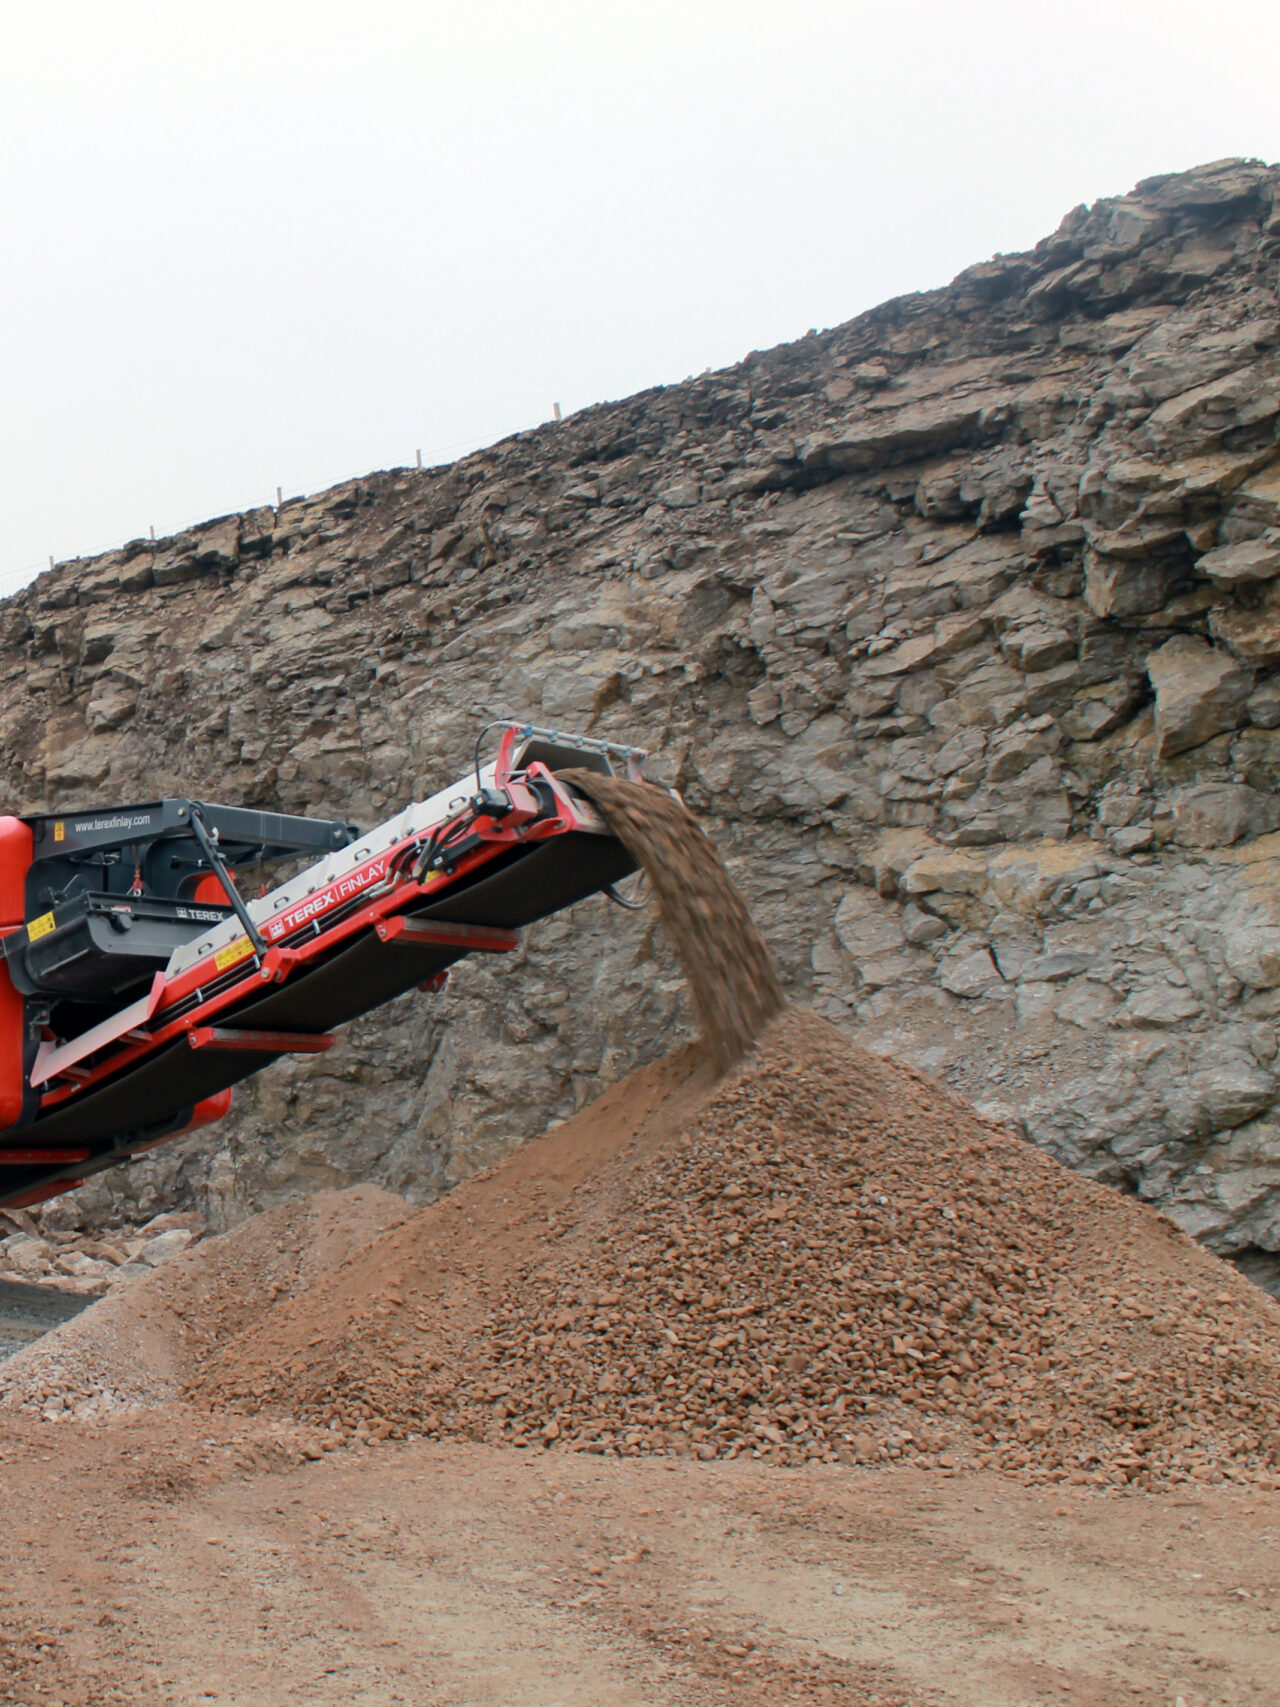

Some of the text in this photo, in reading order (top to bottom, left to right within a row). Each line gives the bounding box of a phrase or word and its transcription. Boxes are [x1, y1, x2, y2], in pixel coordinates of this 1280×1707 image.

[74, 814, 151, 833] www.terexfinlay.com
[284, 860, 386, 928] TEREX FINLAY
[188, 909, 224, 921] TEREX
